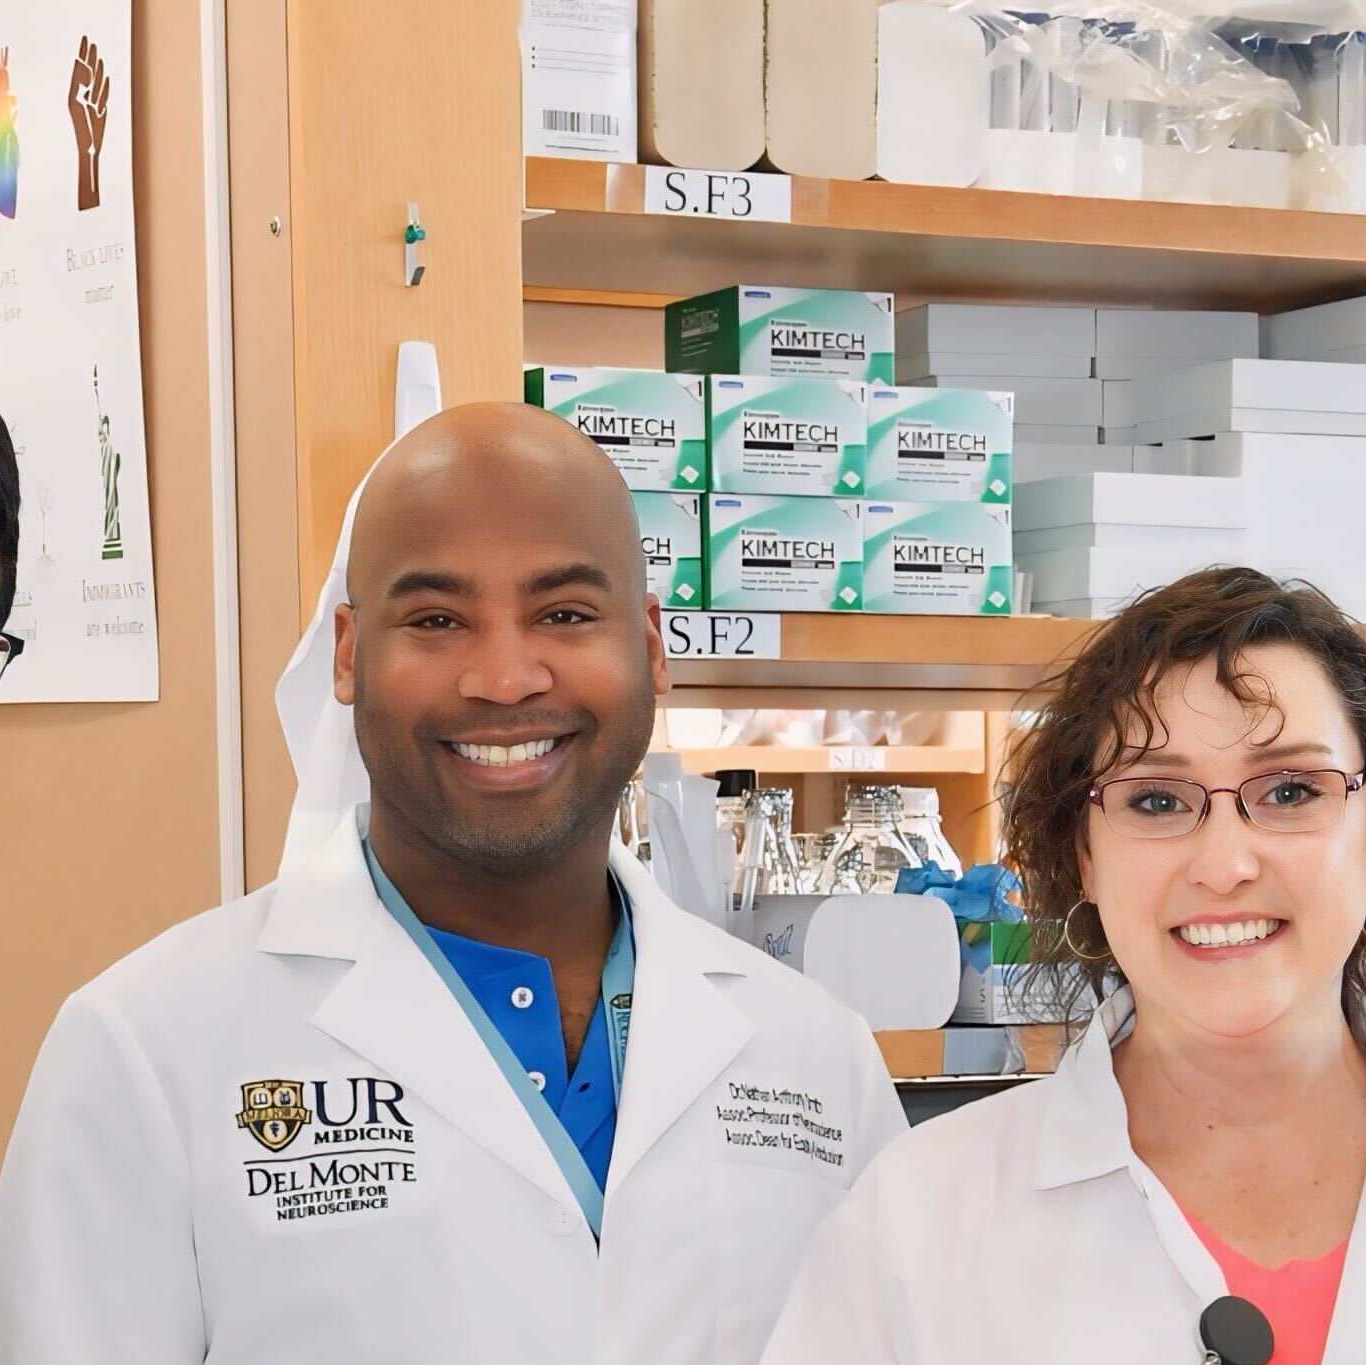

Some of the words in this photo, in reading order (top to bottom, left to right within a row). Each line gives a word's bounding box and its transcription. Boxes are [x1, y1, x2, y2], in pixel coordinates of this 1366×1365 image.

[664, 171, 753, 217] S.F3
[771, 329, 866, 351] KIMTECH
[578, 415, 675, 436] KIMTECH
[743, 421, 838, 443] KIMTECH
[898, 430, 986, 451] KIMTECH
[741, 539, 835, 559] KIMTECH
[893, 544, 984, 564] KIMTECH
[668, 615, 755, 655] S.F2
[310, 1077, 414, 1127] UR
[314, 1127, 414, 1145] MEDICINE
[276, 1187, 353, 1208] INSTITUTE
[358, 1185, 388, 1197] FOR
[276, 1198, 388, 1222] NEUROSCIENCE
